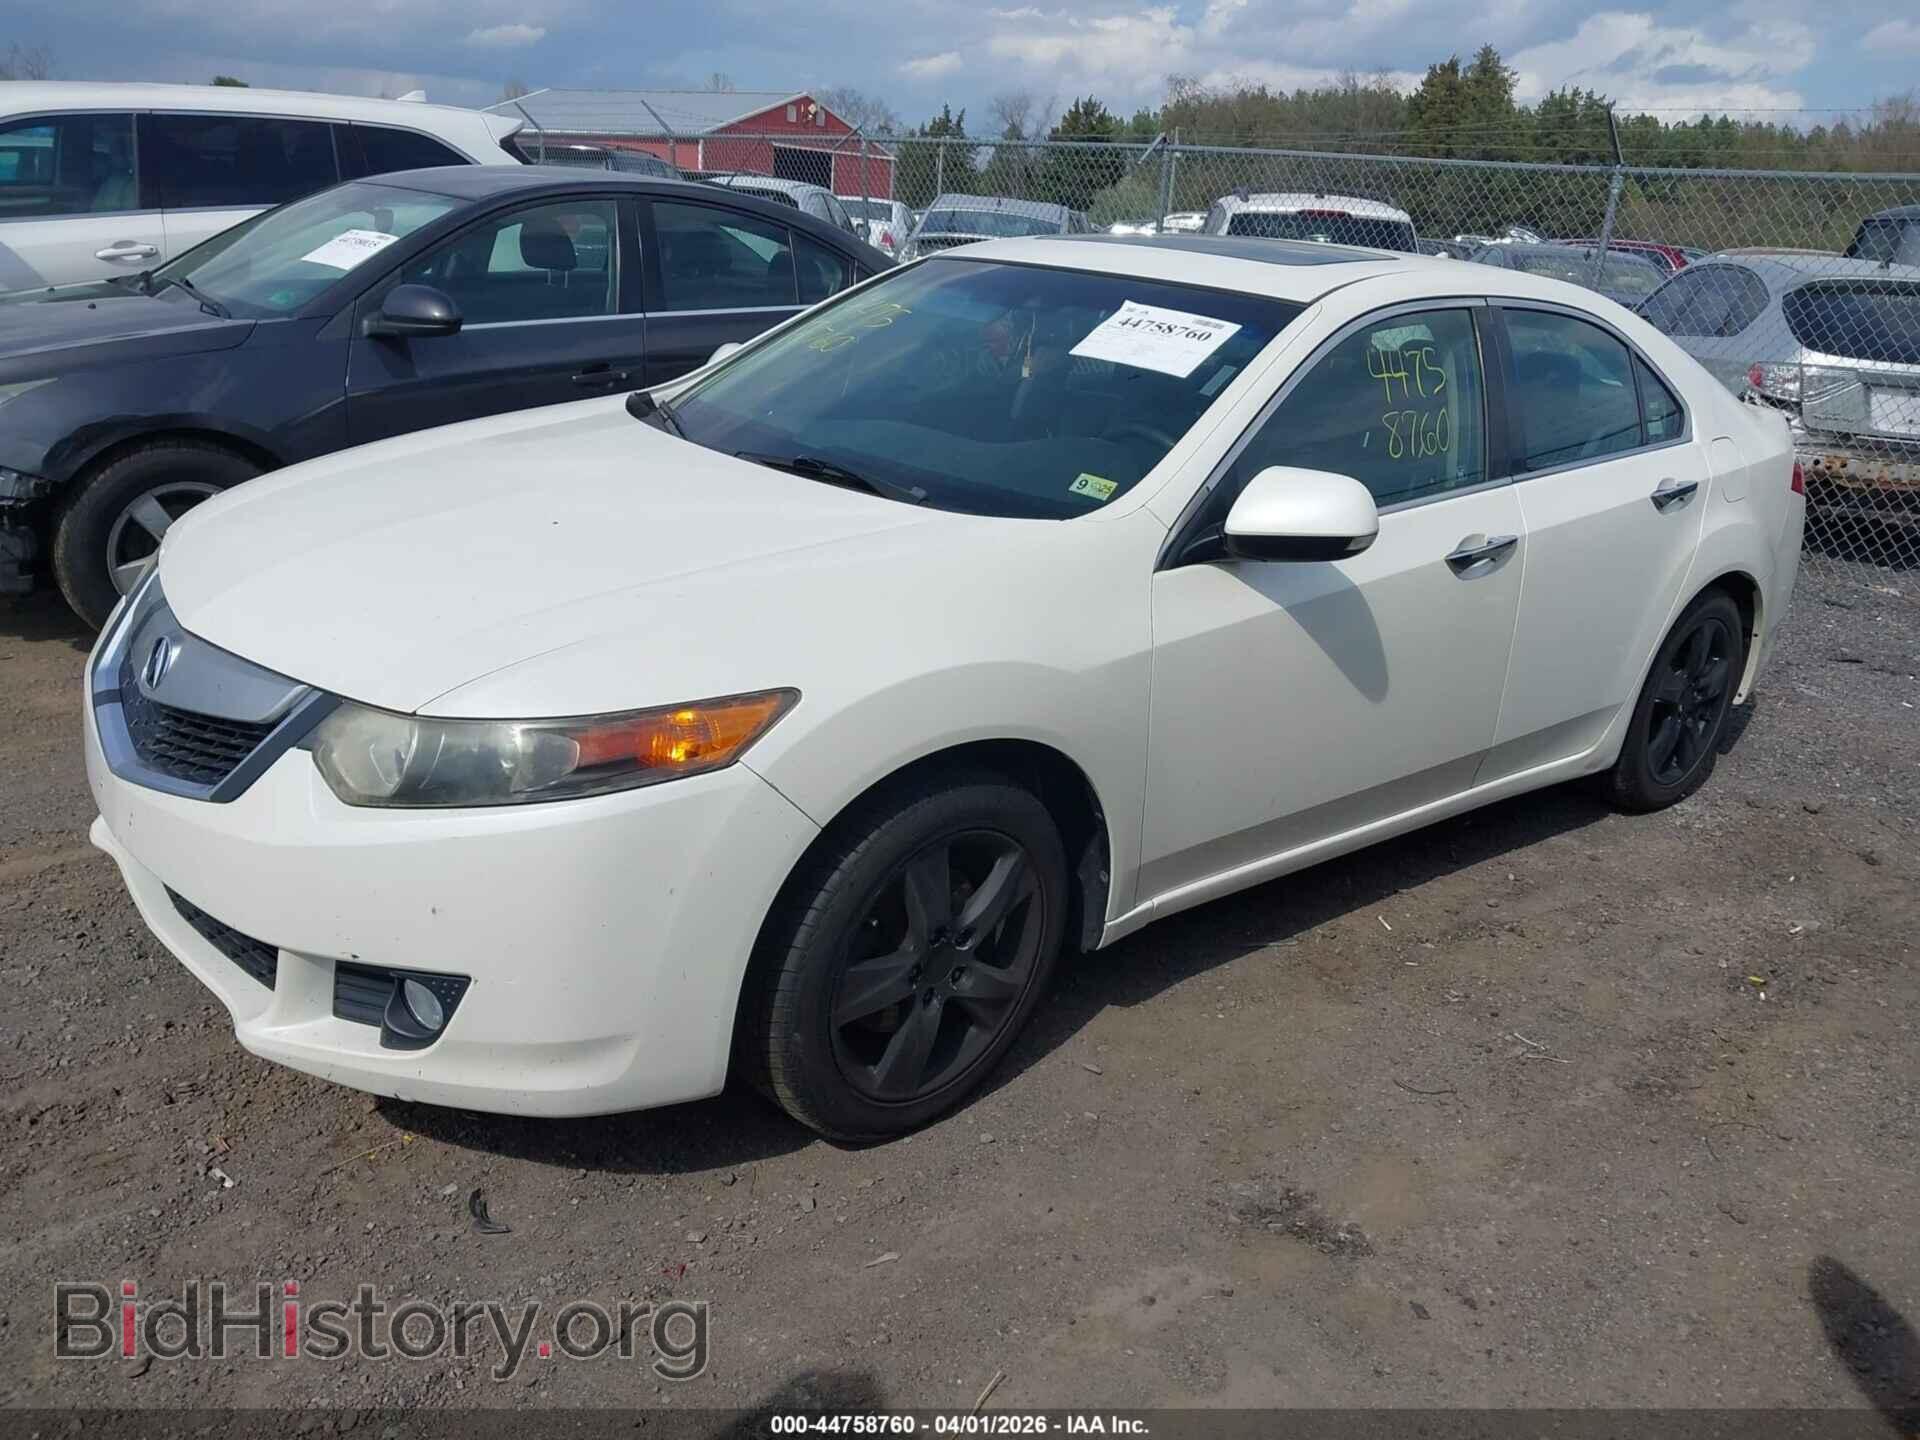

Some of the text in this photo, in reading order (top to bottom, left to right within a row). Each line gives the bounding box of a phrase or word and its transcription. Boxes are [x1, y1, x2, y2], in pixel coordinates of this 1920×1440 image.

[1118, 316, 1212, 341] 44758760
[1366, 346, 1446, 403] 4475
[1382, 407, 1450, 459] 8760
[1076, 479, 1089, 490] 9
